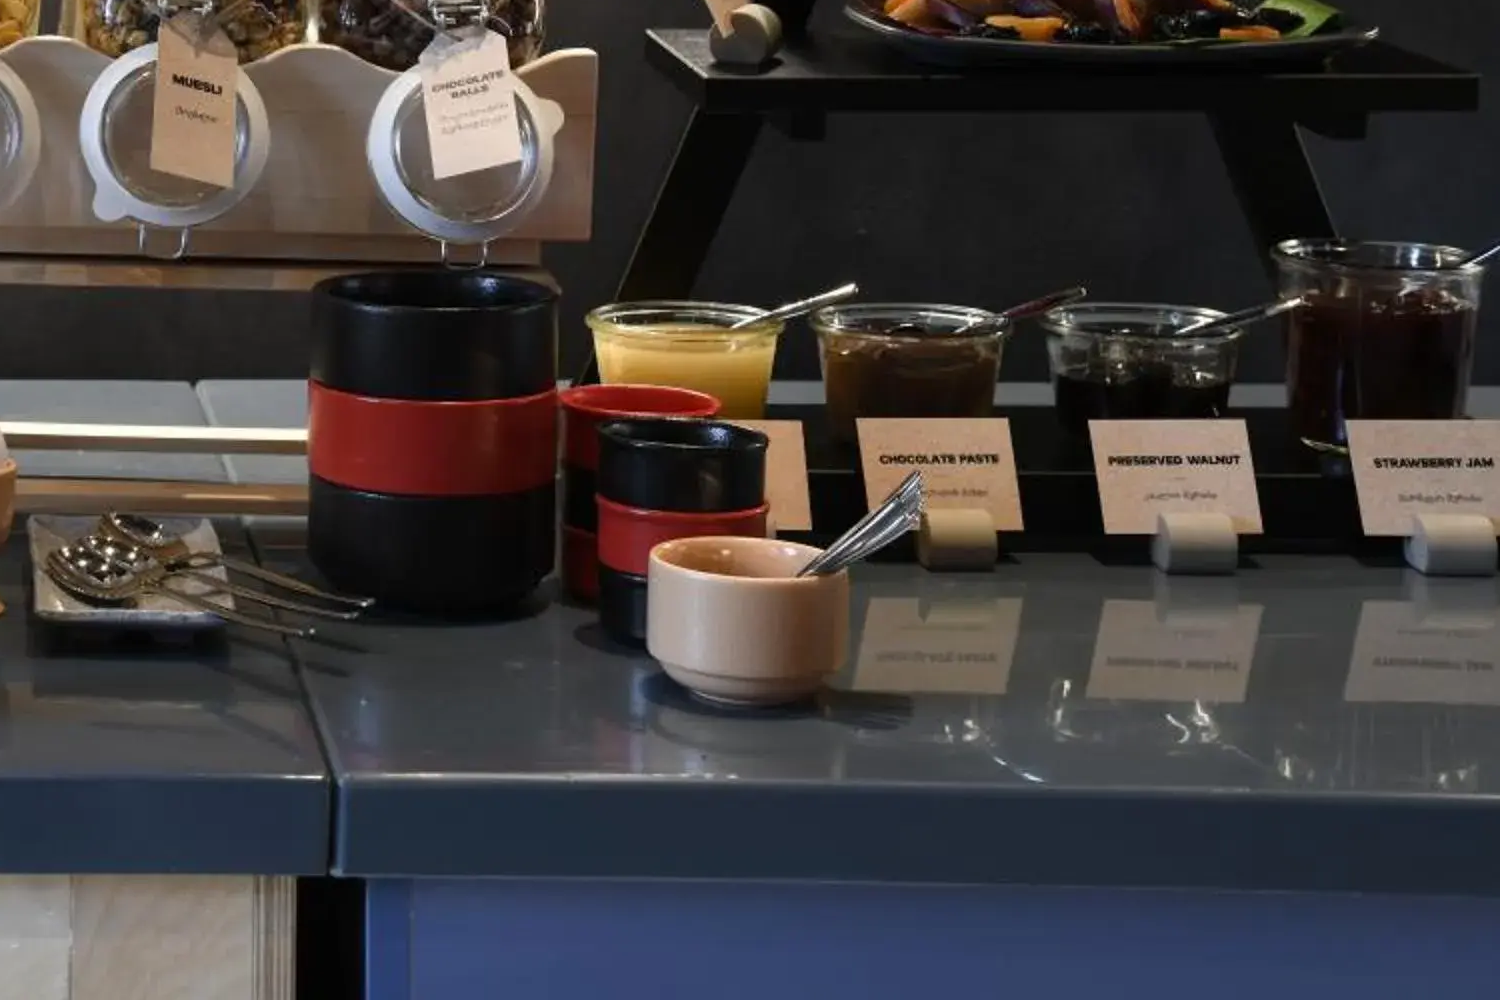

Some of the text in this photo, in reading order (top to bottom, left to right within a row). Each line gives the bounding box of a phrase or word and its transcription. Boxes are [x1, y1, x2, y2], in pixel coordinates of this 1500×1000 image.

[171, 73, 223, 96] MUESLI
[431, 70, 505, 93] CHOCOLATE
[450, 84, 490, 99] BALLS
[879, 453, 1000, 465] CHOCOLATE PASTE
[1107, 455, 1241, 466] PRESERVED WALNUT
[1372, 457, 1495, 469] STRAWBERRY JAM
